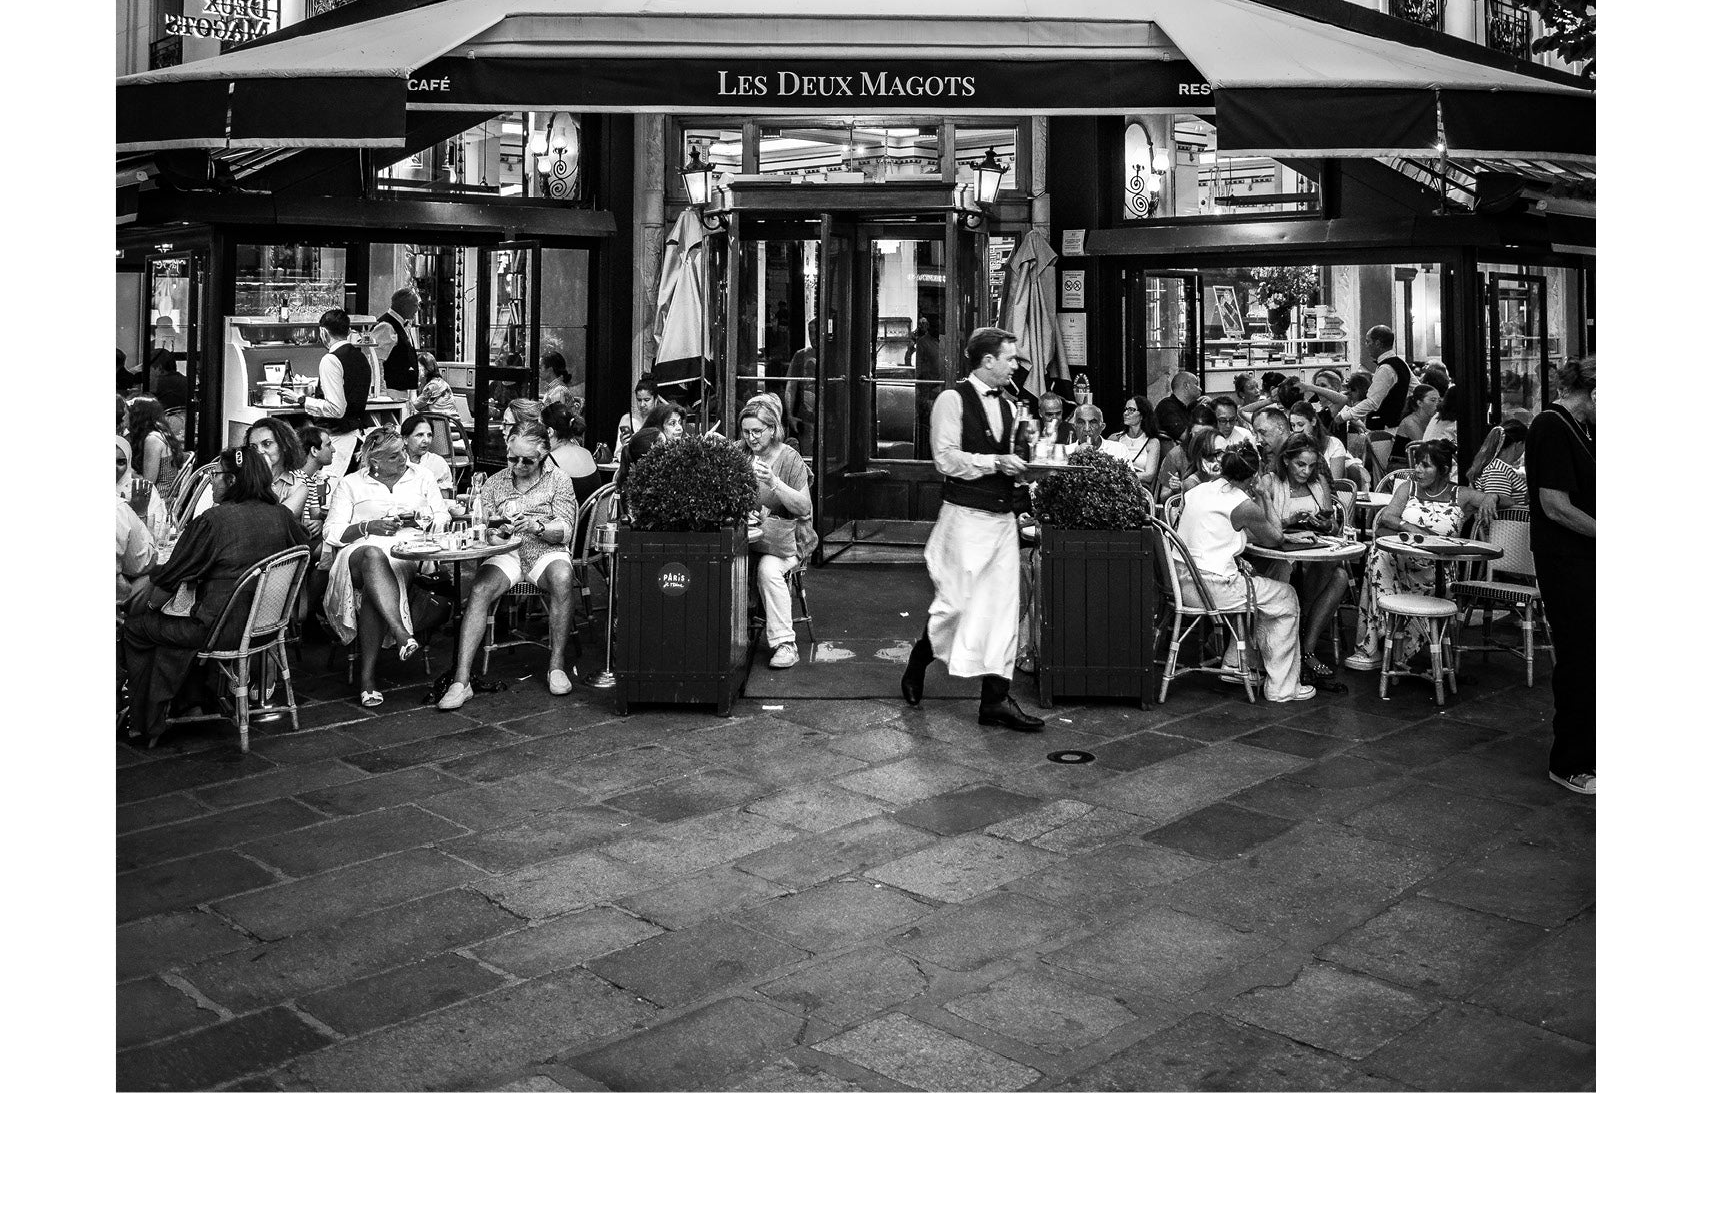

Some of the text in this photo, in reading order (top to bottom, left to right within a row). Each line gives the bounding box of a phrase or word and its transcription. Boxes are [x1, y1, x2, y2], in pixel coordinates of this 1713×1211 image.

[407, 76, 451, 91] CAFÉ
[717, 70, 976, 97] LES DEUX MAGOTS
